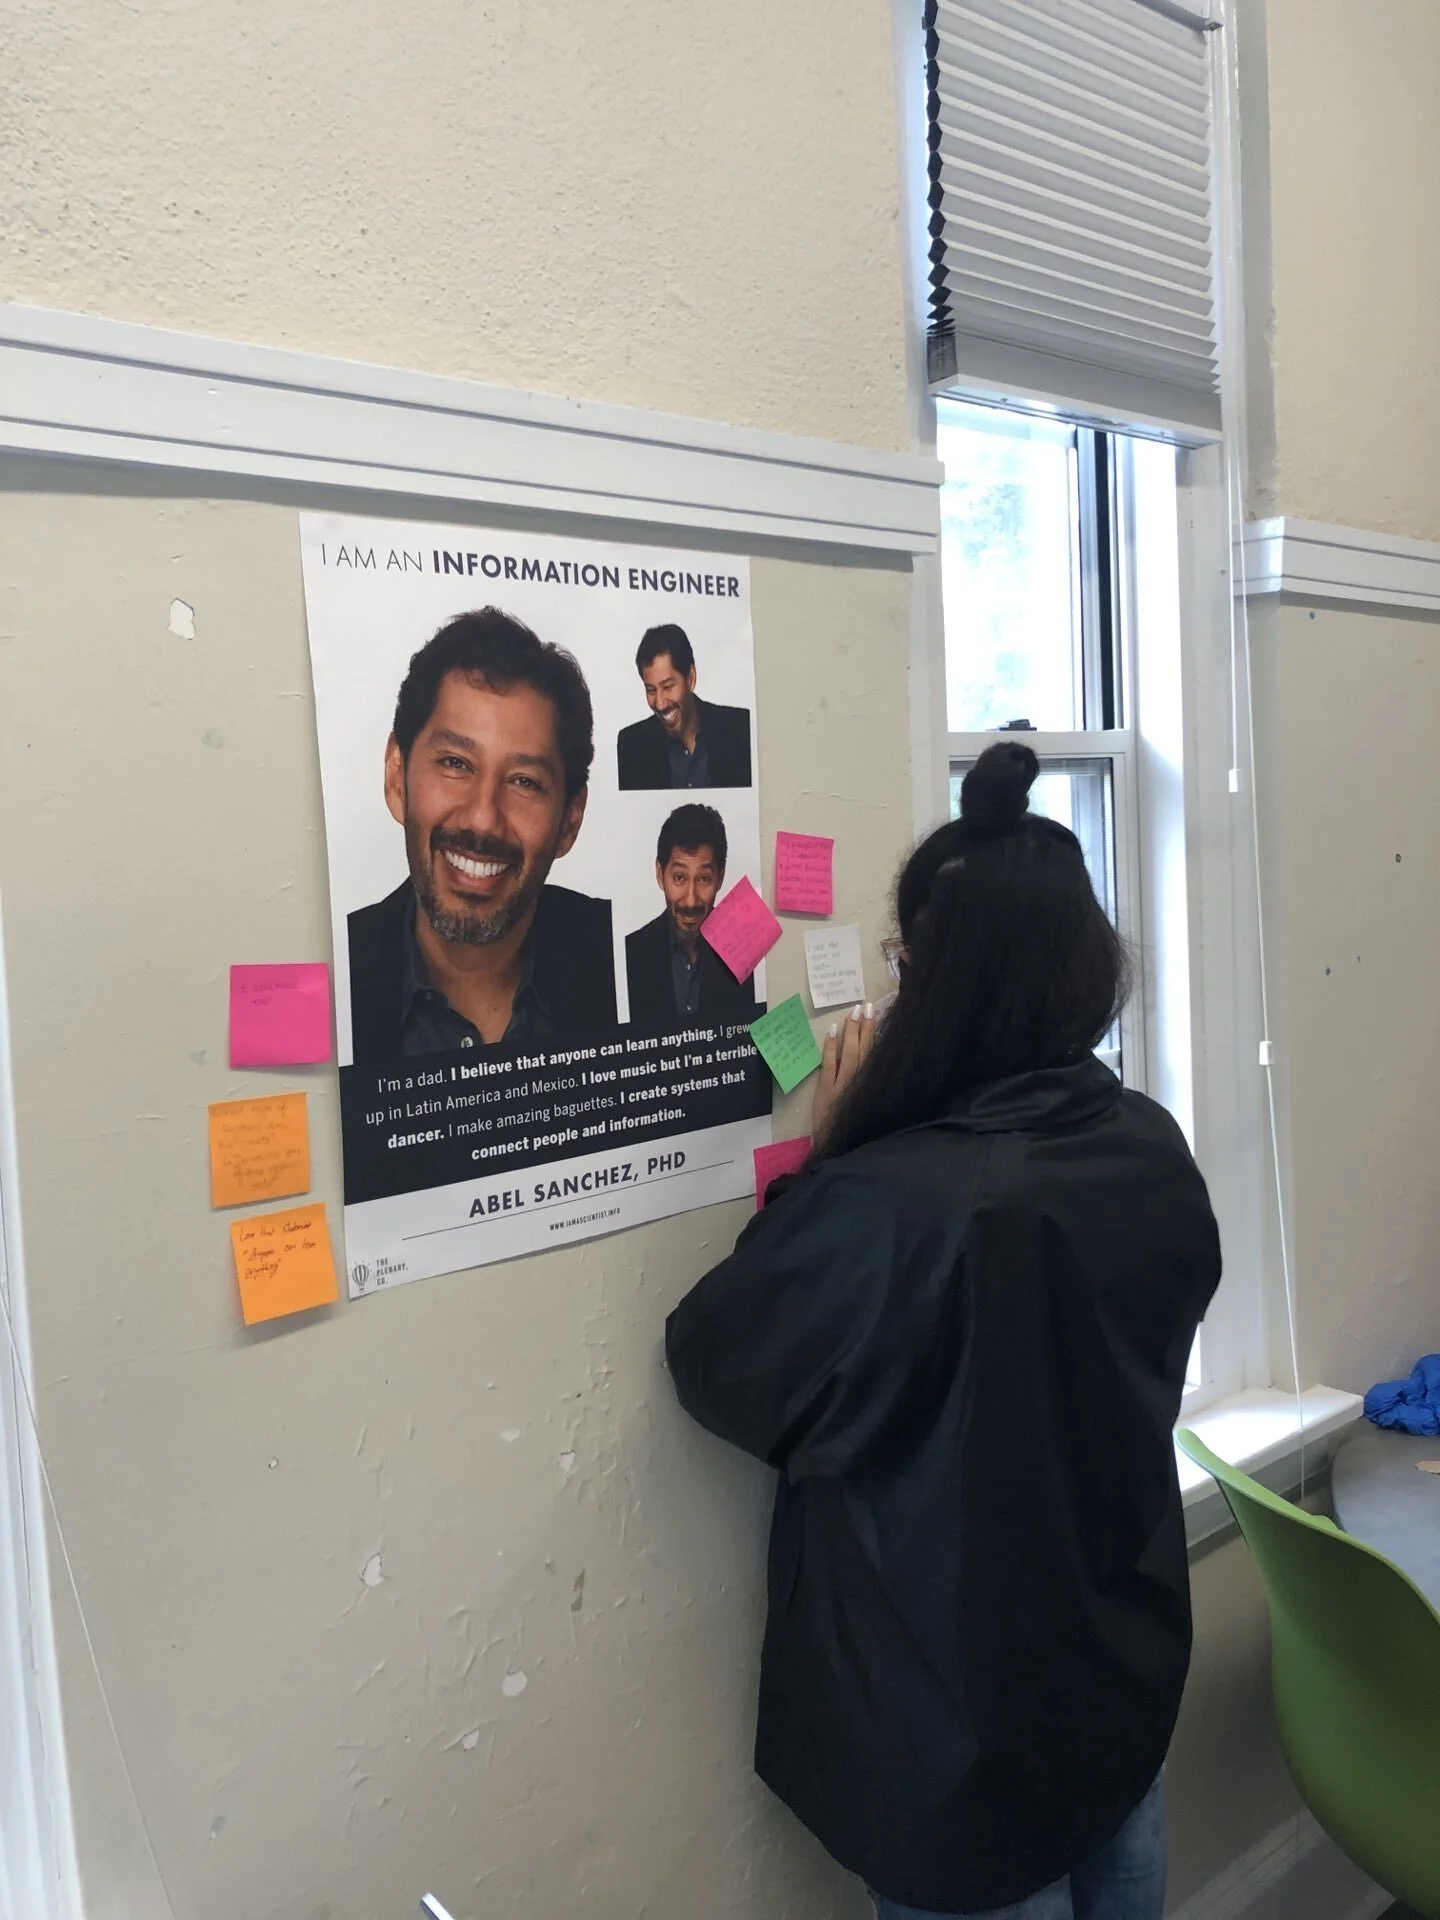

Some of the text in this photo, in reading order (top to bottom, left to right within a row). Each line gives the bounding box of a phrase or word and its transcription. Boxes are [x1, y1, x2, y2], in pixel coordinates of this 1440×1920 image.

[322, 543, 740, 598] I AM AN INFORMATION ENGINEER
[366, 1044, 757, 1126] up in Latin America and Mexico. I love music but I'm a terrible
[377, 1023, 750, 1093] I'm a dad. I believe that anyone can learn anything. I grew
[387, 1069, 746, 1149] dancer. I make amazing baguettes. I create systems that
[471, 1107, 686, 1160] connect people and information.
[469, 1151, 686, 1218] ABEL SANCHEZ, PHD
[376, 1257, 389, 1267] THE
